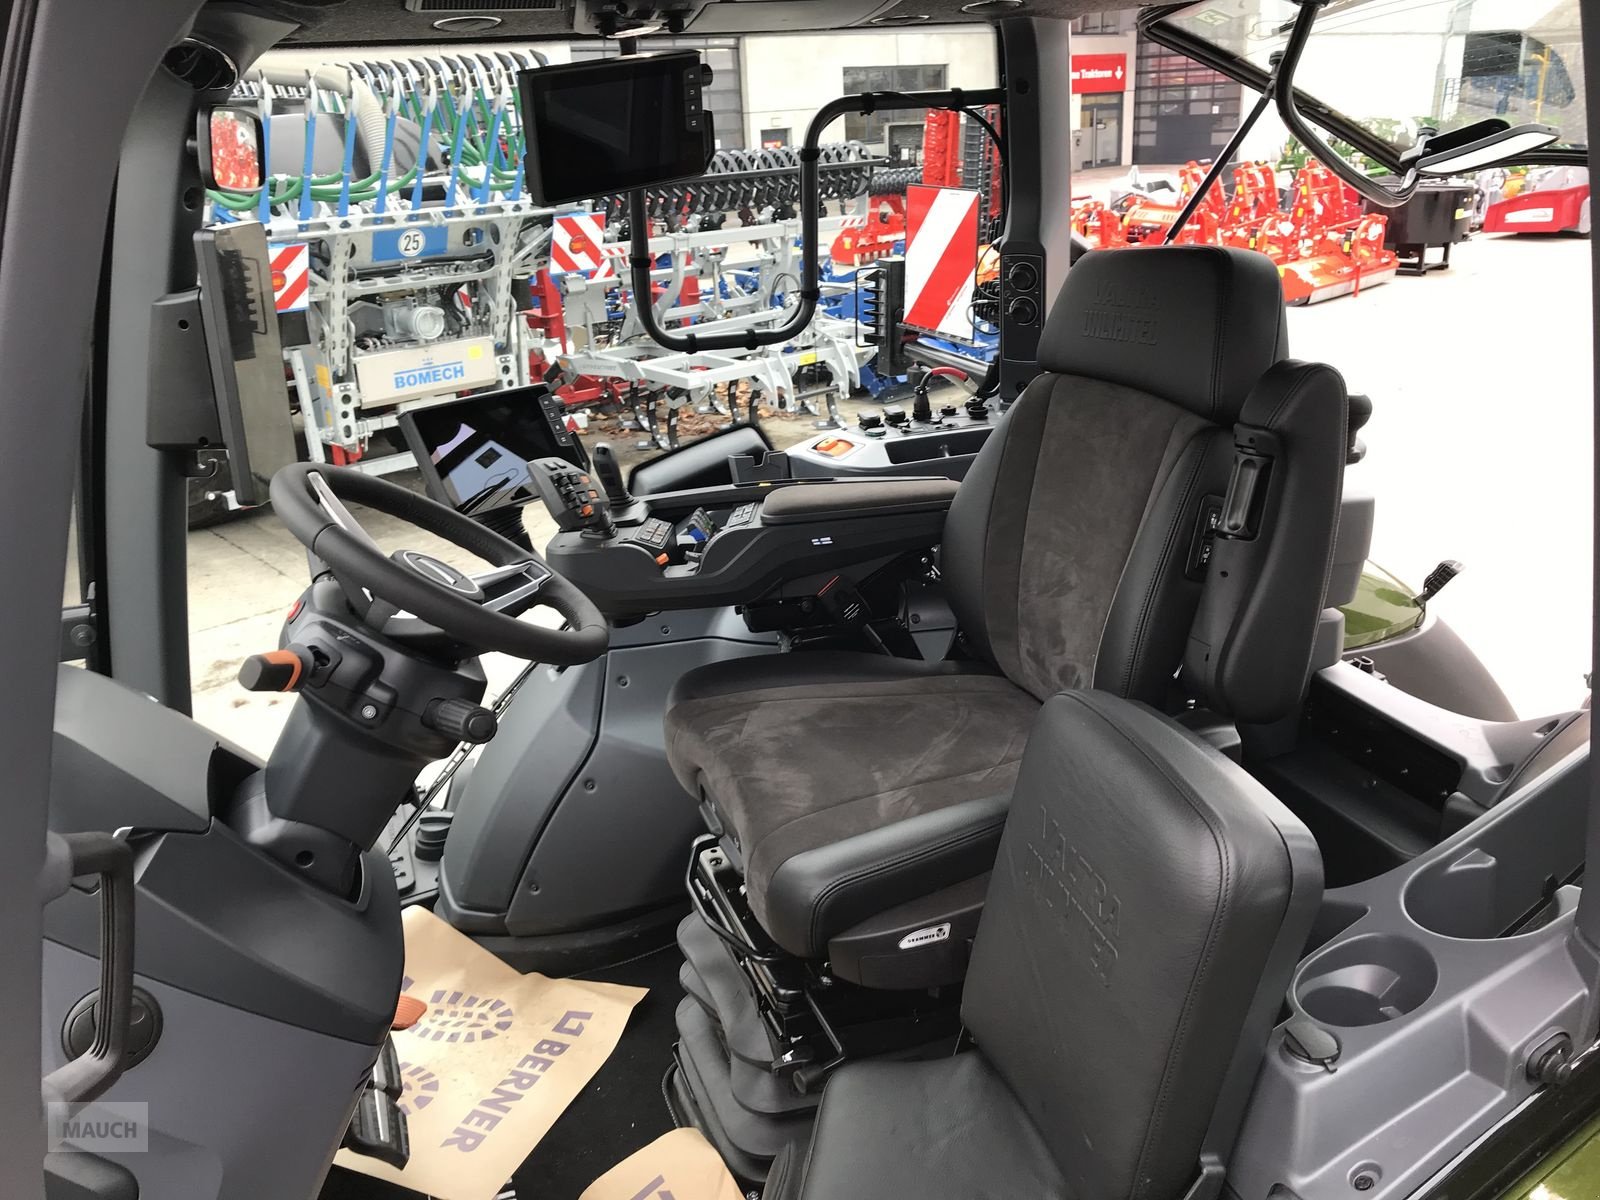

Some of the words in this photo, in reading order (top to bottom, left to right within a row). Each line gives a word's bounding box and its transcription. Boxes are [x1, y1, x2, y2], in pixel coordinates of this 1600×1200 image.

[404, 233, 420, 251] 25
[1093, 279, 1161, 310] VAL
[394, 366, 464, 389] BOMECH
[439, 1038, 571, 1152] BERNER
